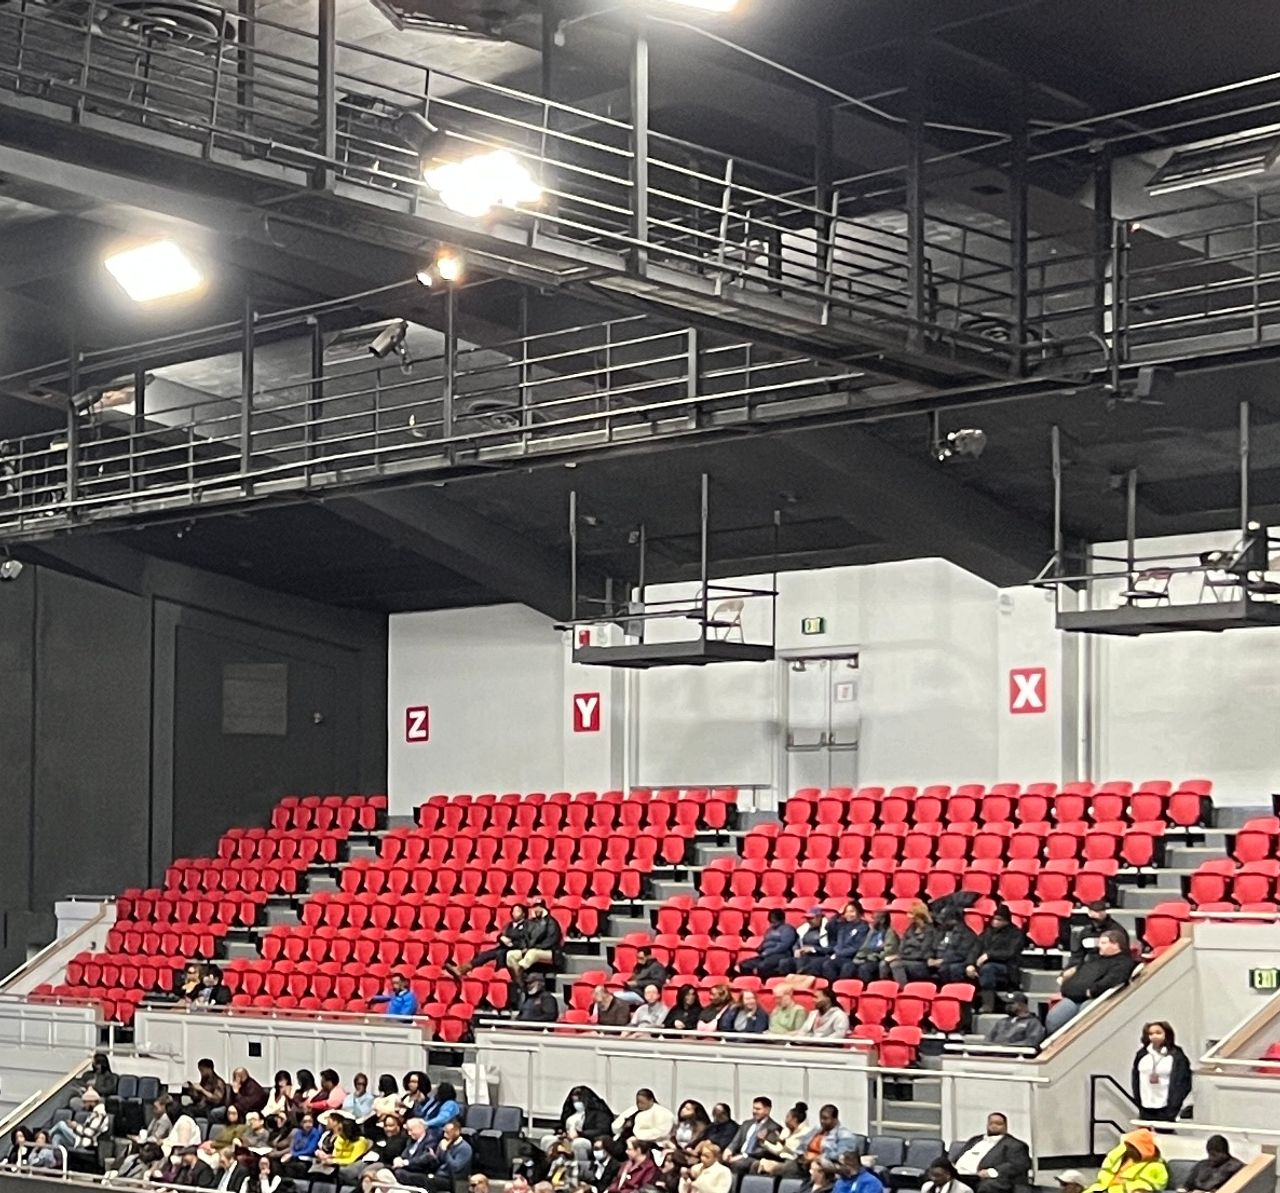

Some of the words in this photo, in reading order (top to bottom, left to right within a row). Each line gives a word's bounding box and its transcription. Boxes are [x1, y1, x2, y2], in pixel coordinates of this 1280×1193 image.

[1012, 673, 1043, 708] X
[408, 710, 427, 738] Z
[575, 697, 598, 728] Y
